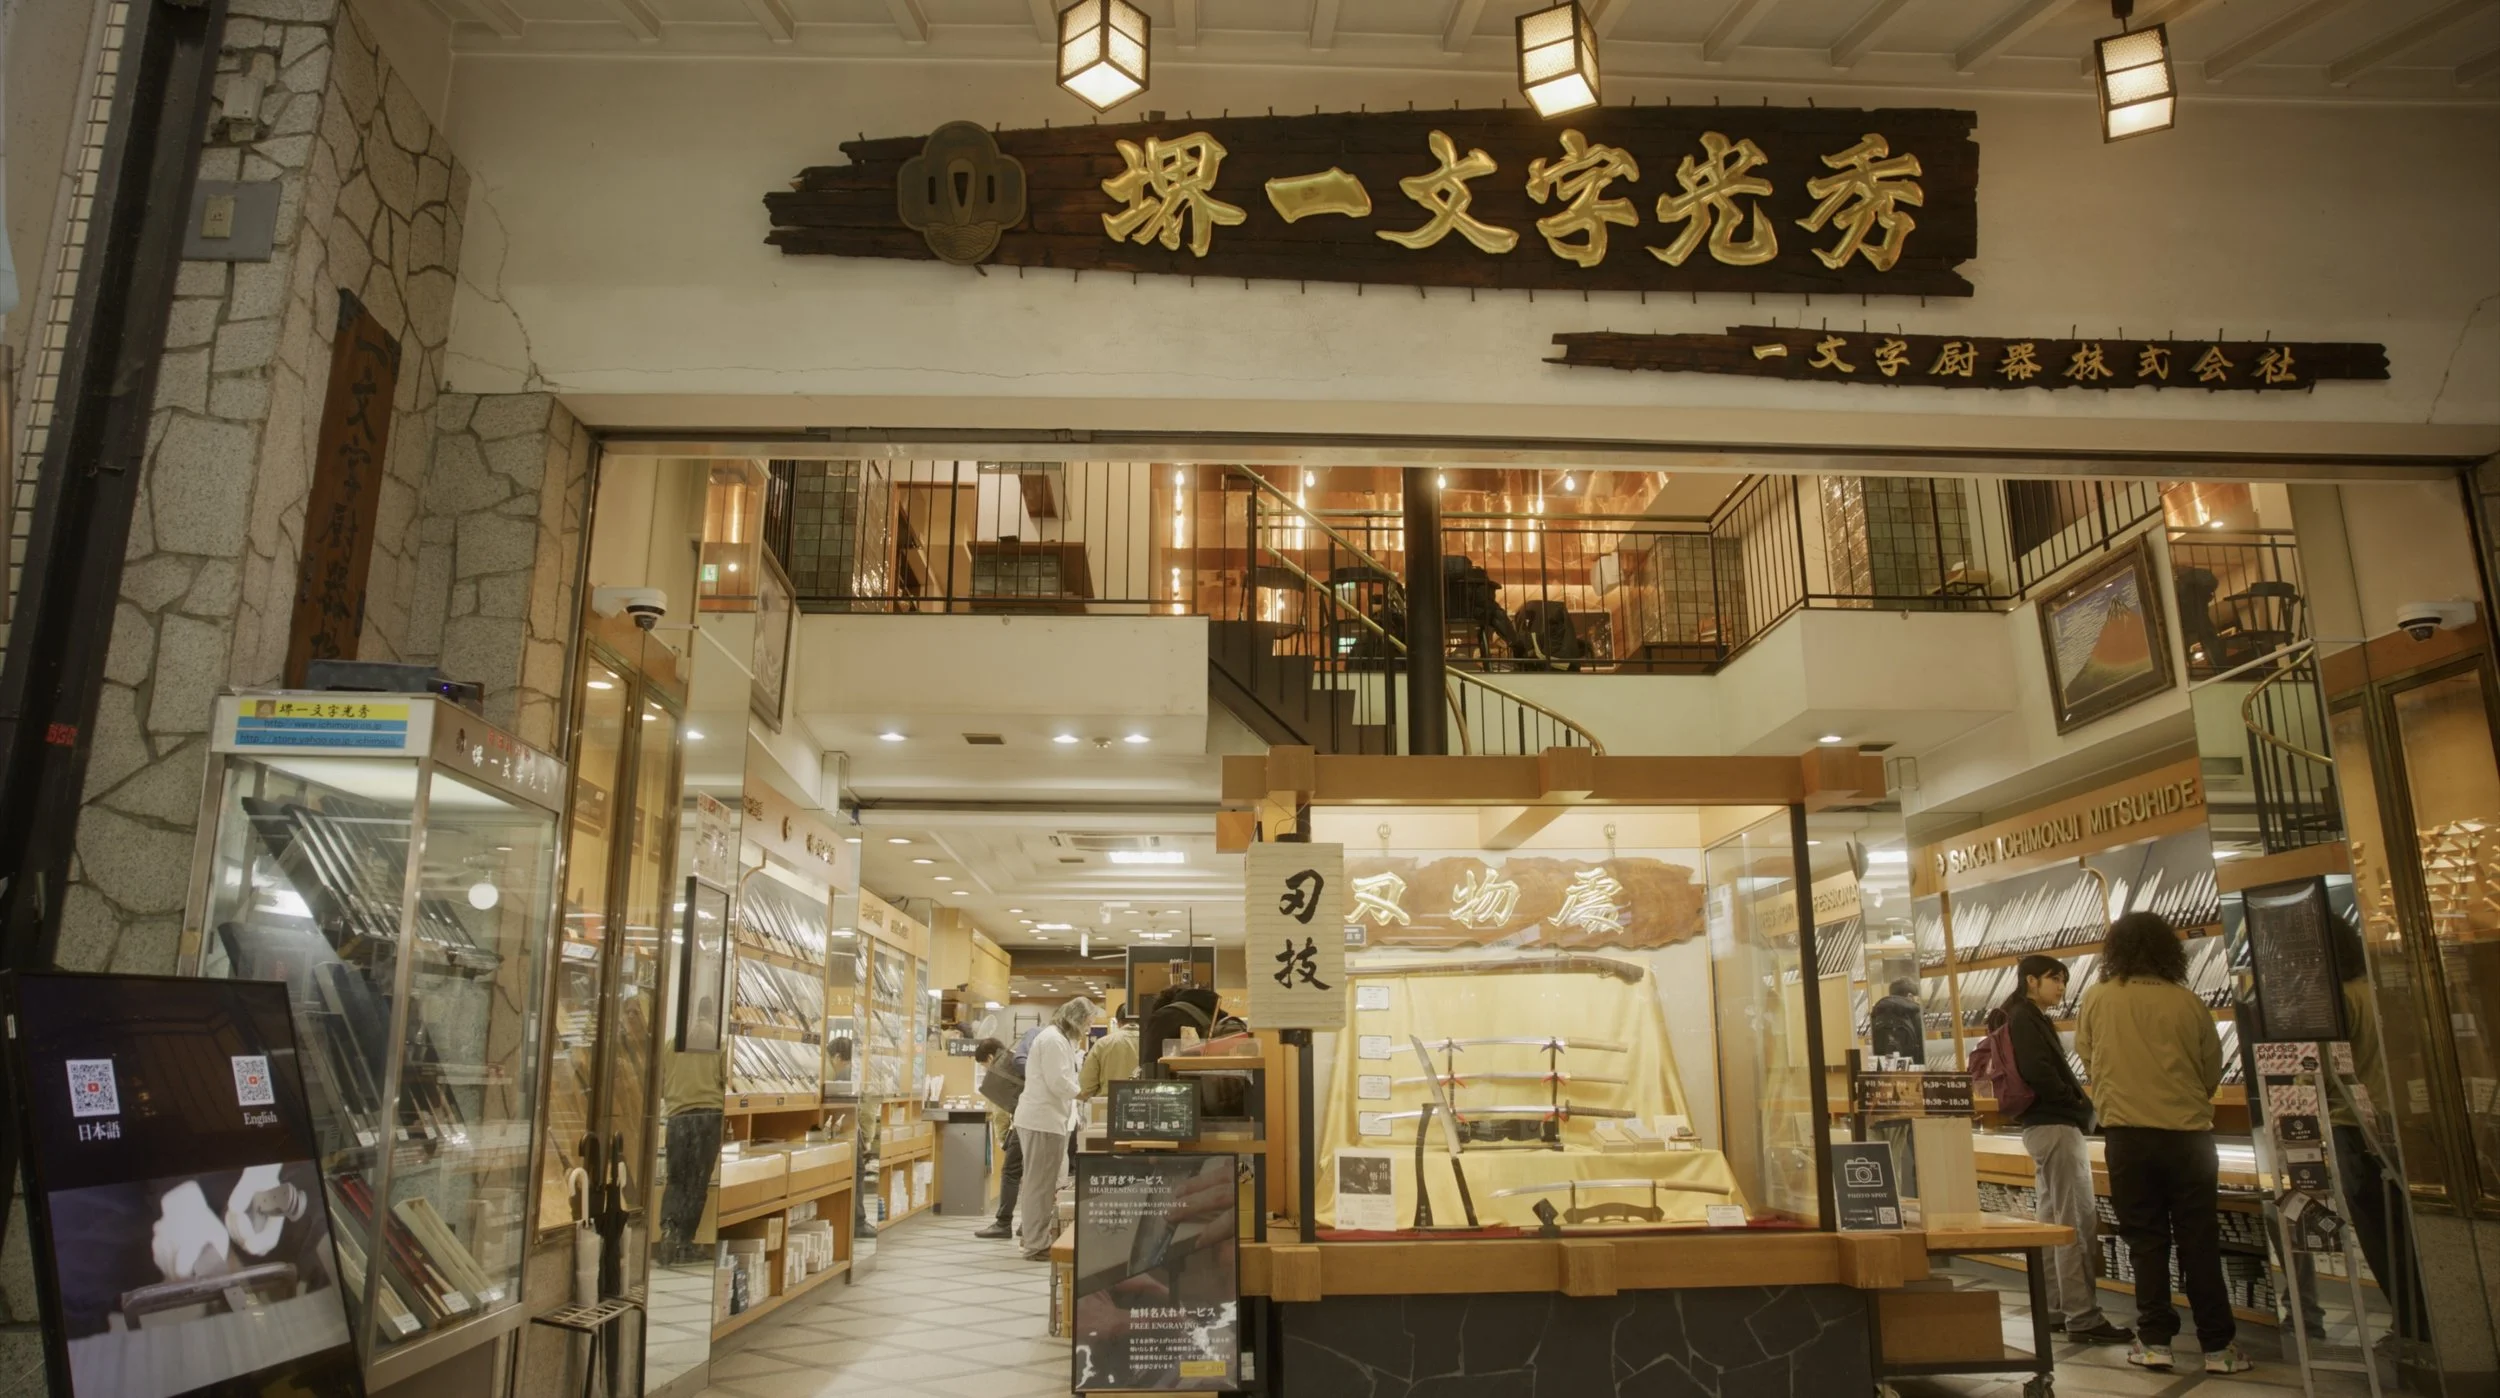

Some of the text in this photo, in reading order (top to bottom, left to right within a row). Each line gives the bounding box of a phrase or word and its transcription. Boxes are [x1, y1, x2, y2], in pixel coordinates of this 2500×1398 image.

[1101, 129, 1925, 272] 堺一文字光秀
[1752, 334, 2298, 384] 一文字厨器株式会社
[1947, 842, 1996, 875] SAKAI
[2087, 777, 2196, 835] MITSUHIDE
[78, 1121, 121, 1142] 日本語
[244, 1110, 278, 1128] English
[1130, 1322, 1149, 1330] FREE
